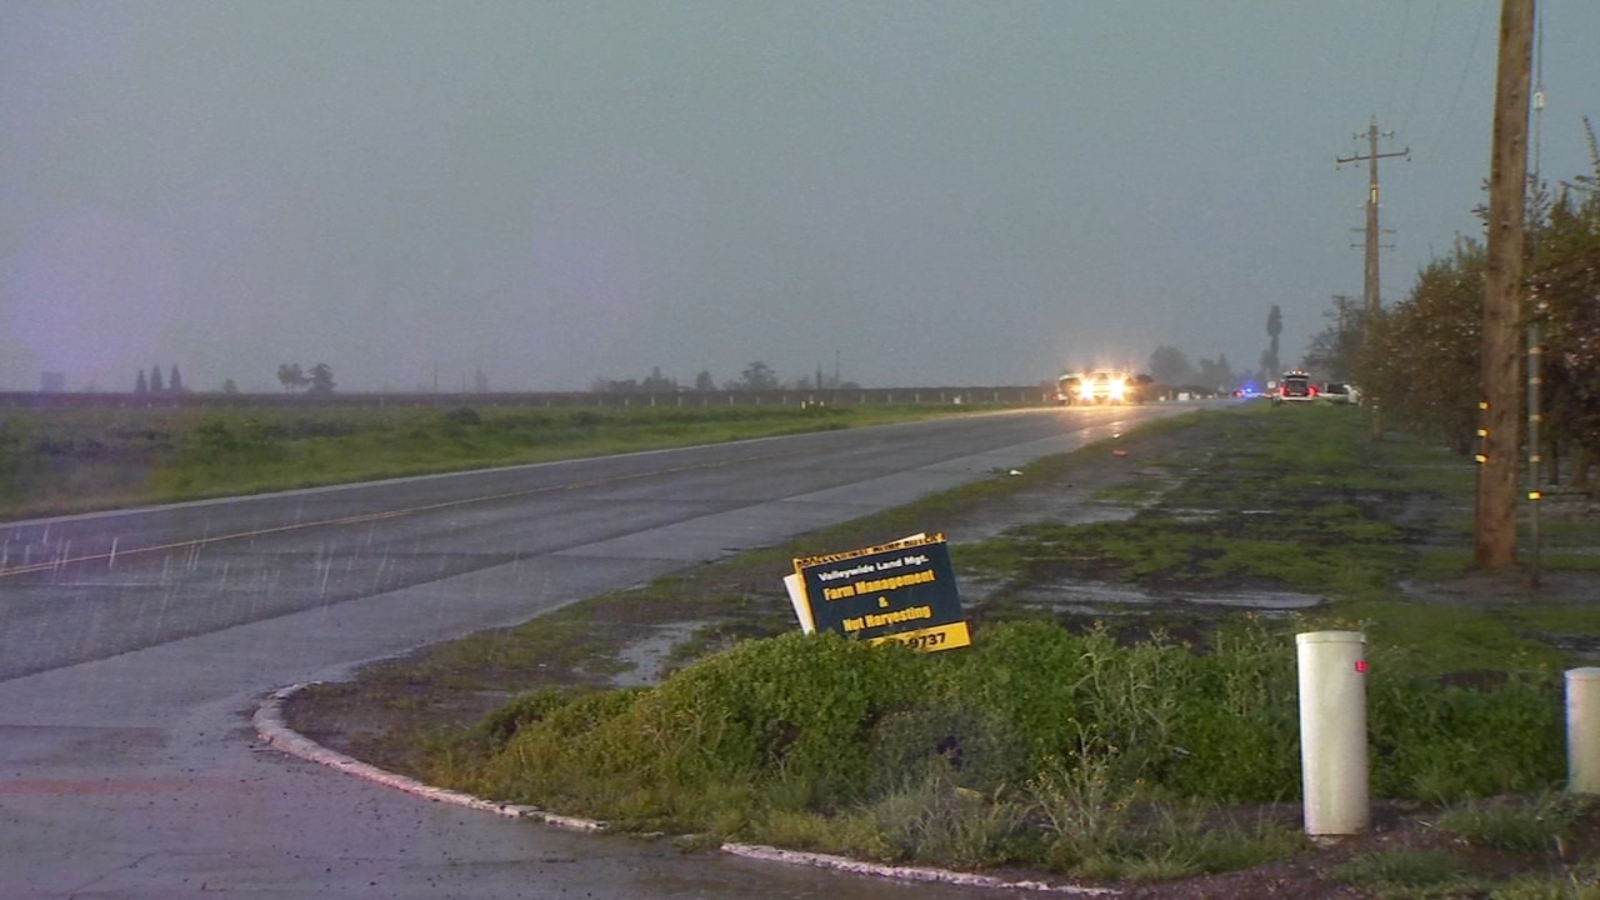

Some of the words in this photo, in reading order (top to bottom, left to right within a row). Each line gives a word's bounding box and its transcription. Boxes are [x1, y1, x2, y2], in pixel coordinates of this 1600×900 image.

[818, 564, 875, 582] Valleywide
[876, 557, 903, 571] Land
[904, 554, 930, 568] Mgt.
[823, 584, 855, 601] Farm
[855, 569, 936, 595] Management
[878, 596, 890, 608] &
[842, 617, 865, 632] Nut
[866, 605, 933, 628] Harvesting
